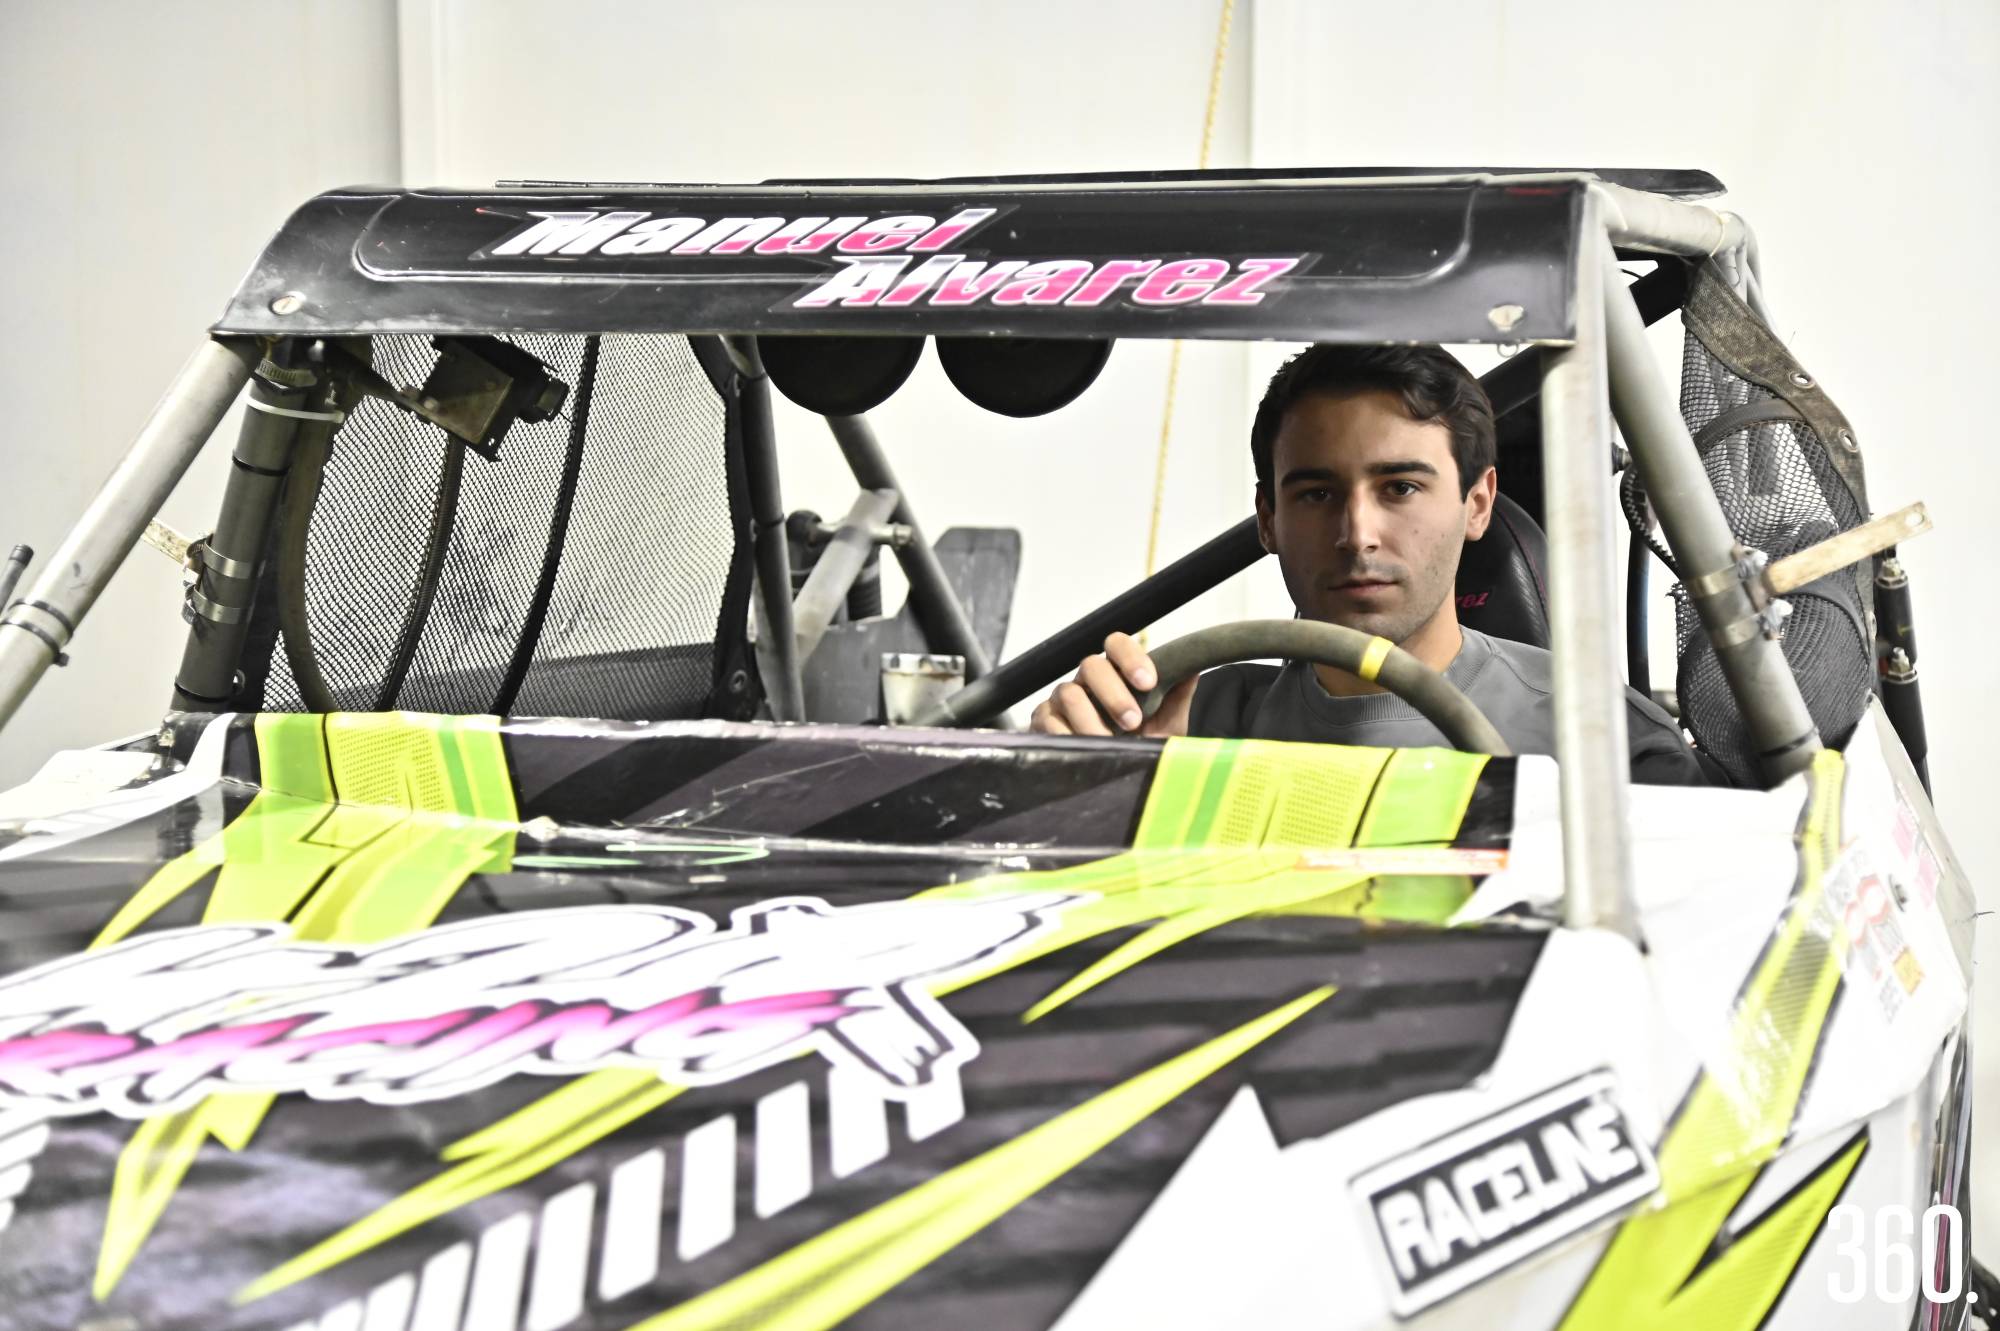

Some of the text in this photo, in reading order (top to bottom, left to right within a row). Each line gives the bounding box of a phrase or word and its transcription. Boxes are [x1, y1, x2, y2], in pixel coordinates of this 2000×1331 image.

[492, 208, 998, 256] Manuel
[793, 254, 1300, 307] Alvarez
[1377, 1102, 1640, 1281] RACELINE
